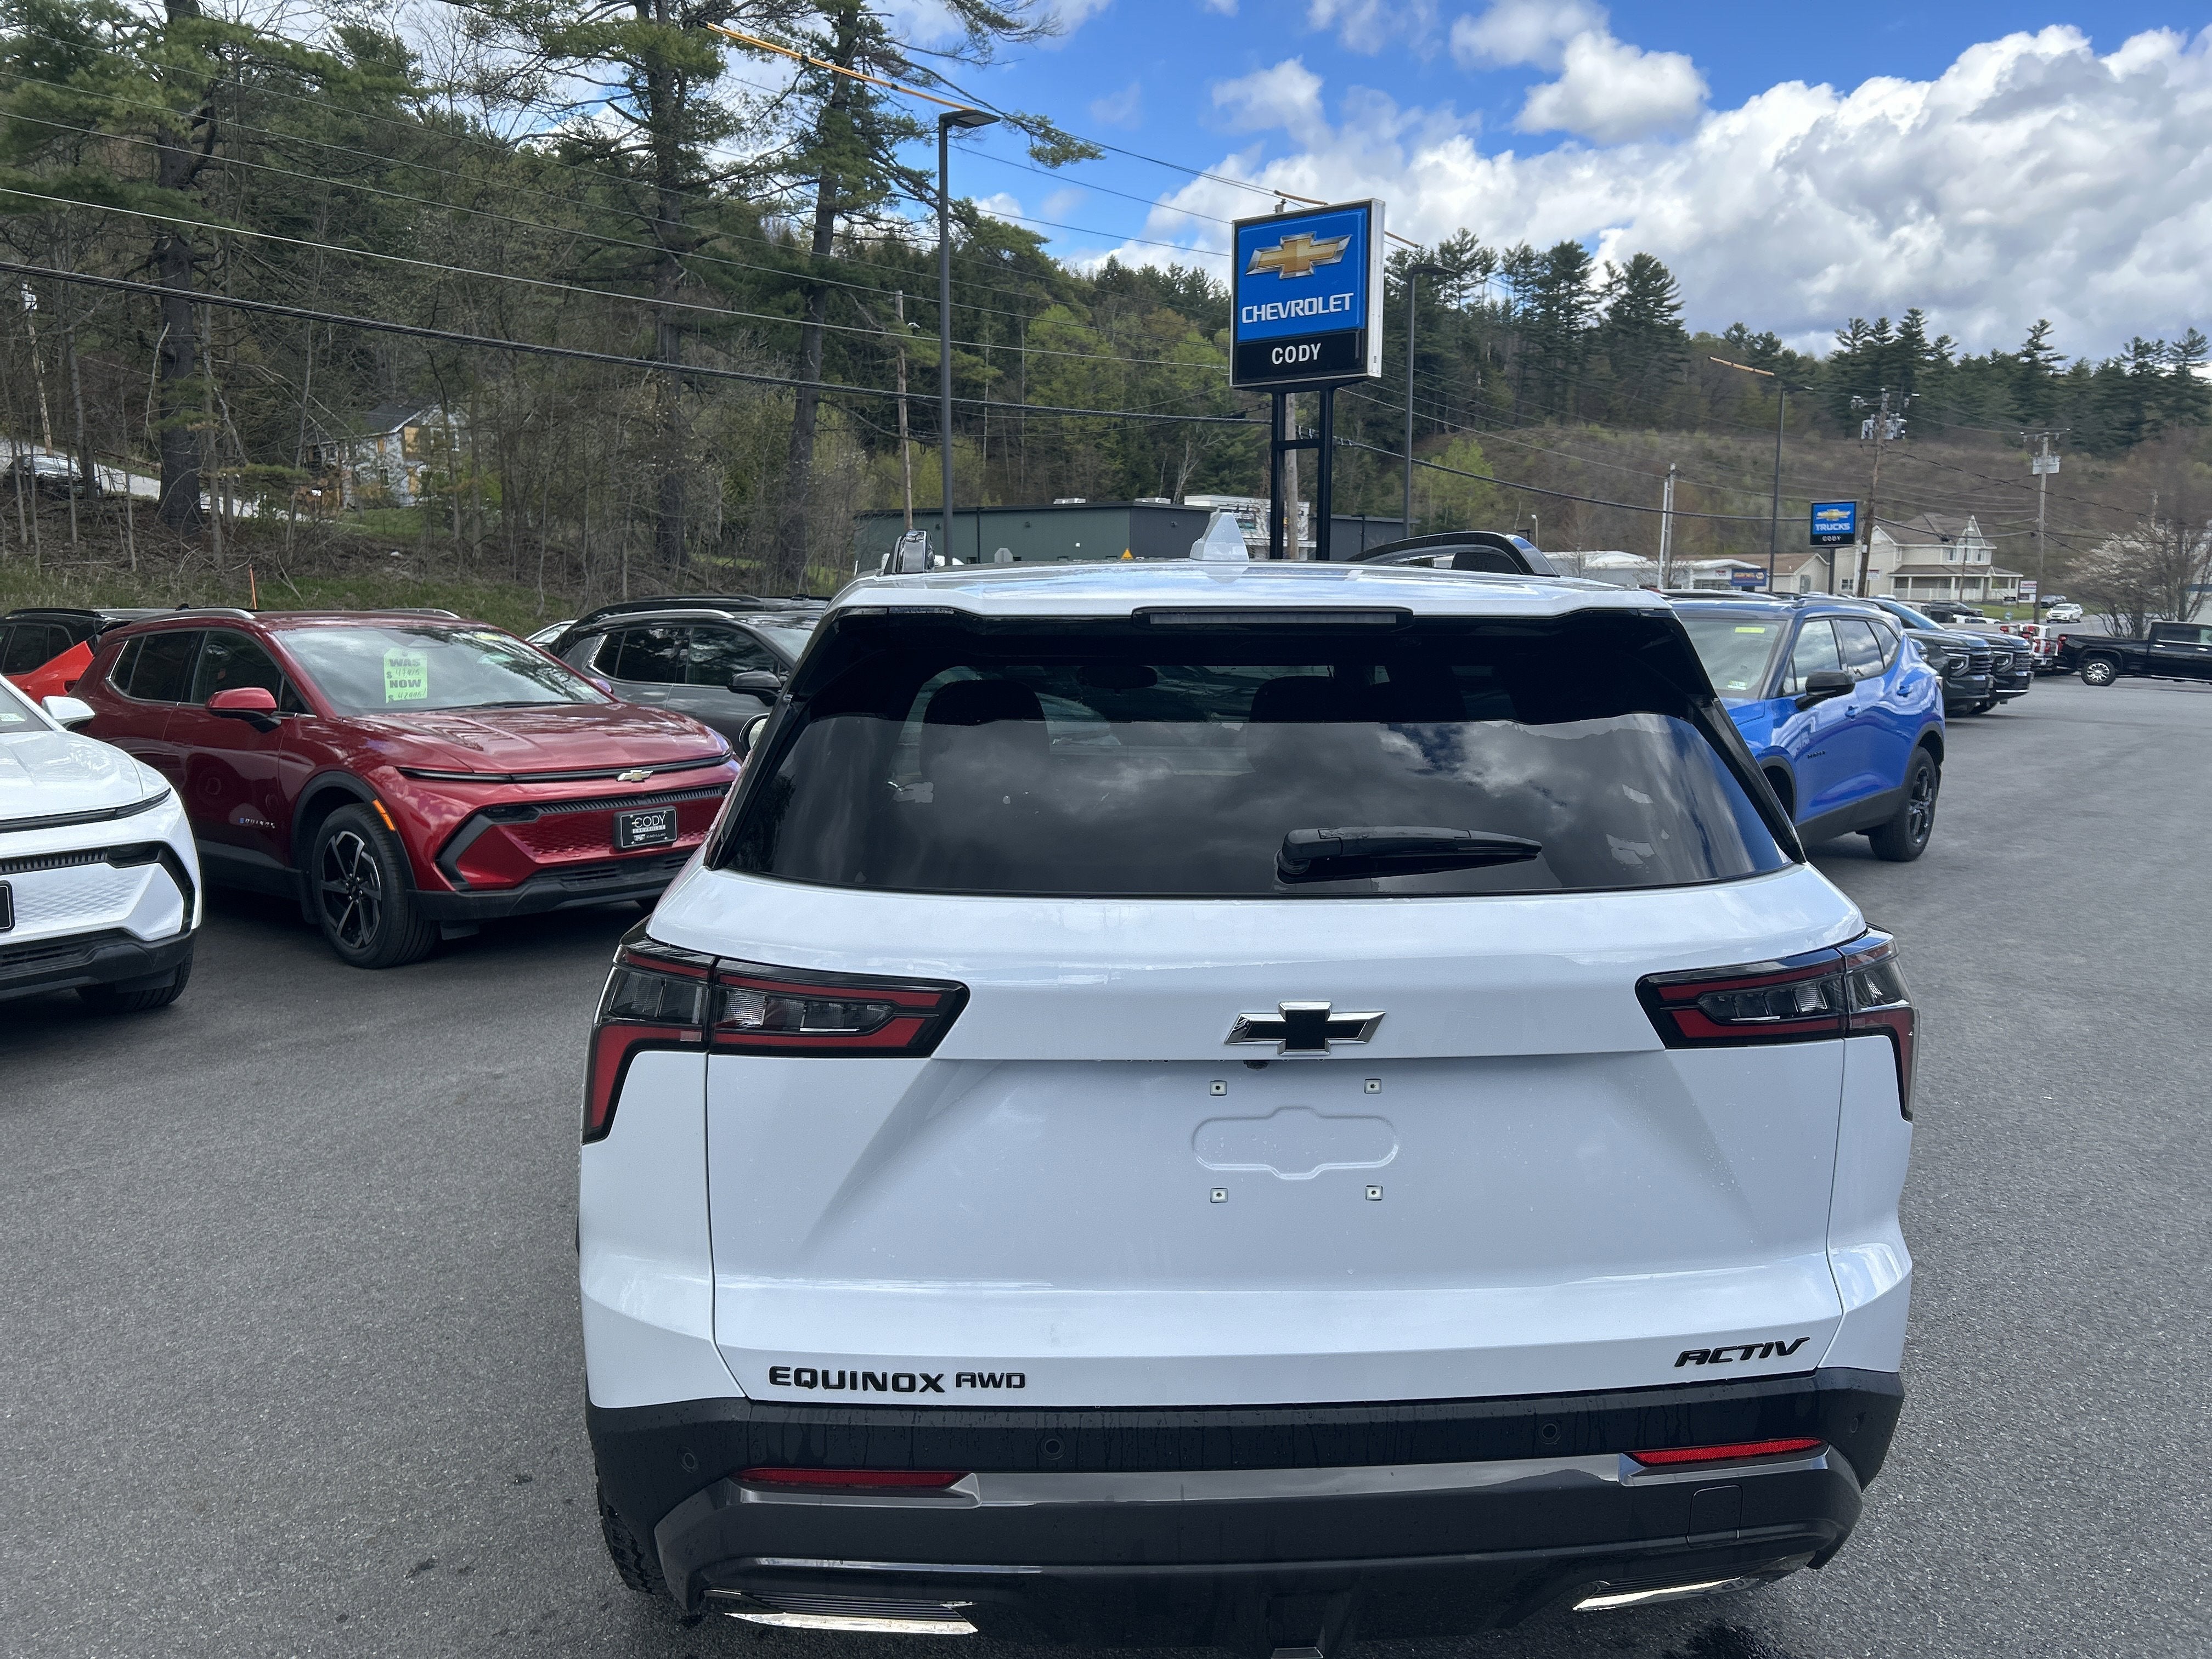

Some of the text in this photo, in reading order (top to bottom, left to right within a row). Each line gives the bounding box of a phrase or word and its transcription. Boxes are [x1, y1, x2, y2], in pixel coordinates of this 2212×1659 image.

[1242, 293, 1354, 324] CHEVROLET
[1271, 342, 1322, 365] CODY
[1815, 522, 1850, 532] TRUCKS
[389, 658, 421, 667] WAS
[386, 671, 392, 679] $
[390, 679, 421, 688] NOW
[634, 814, 665, 828] CODY
[1674, 1336, 1810, 1367] ACTIV
[769, 1365, 1026, 1393] EQUINOX AWD
